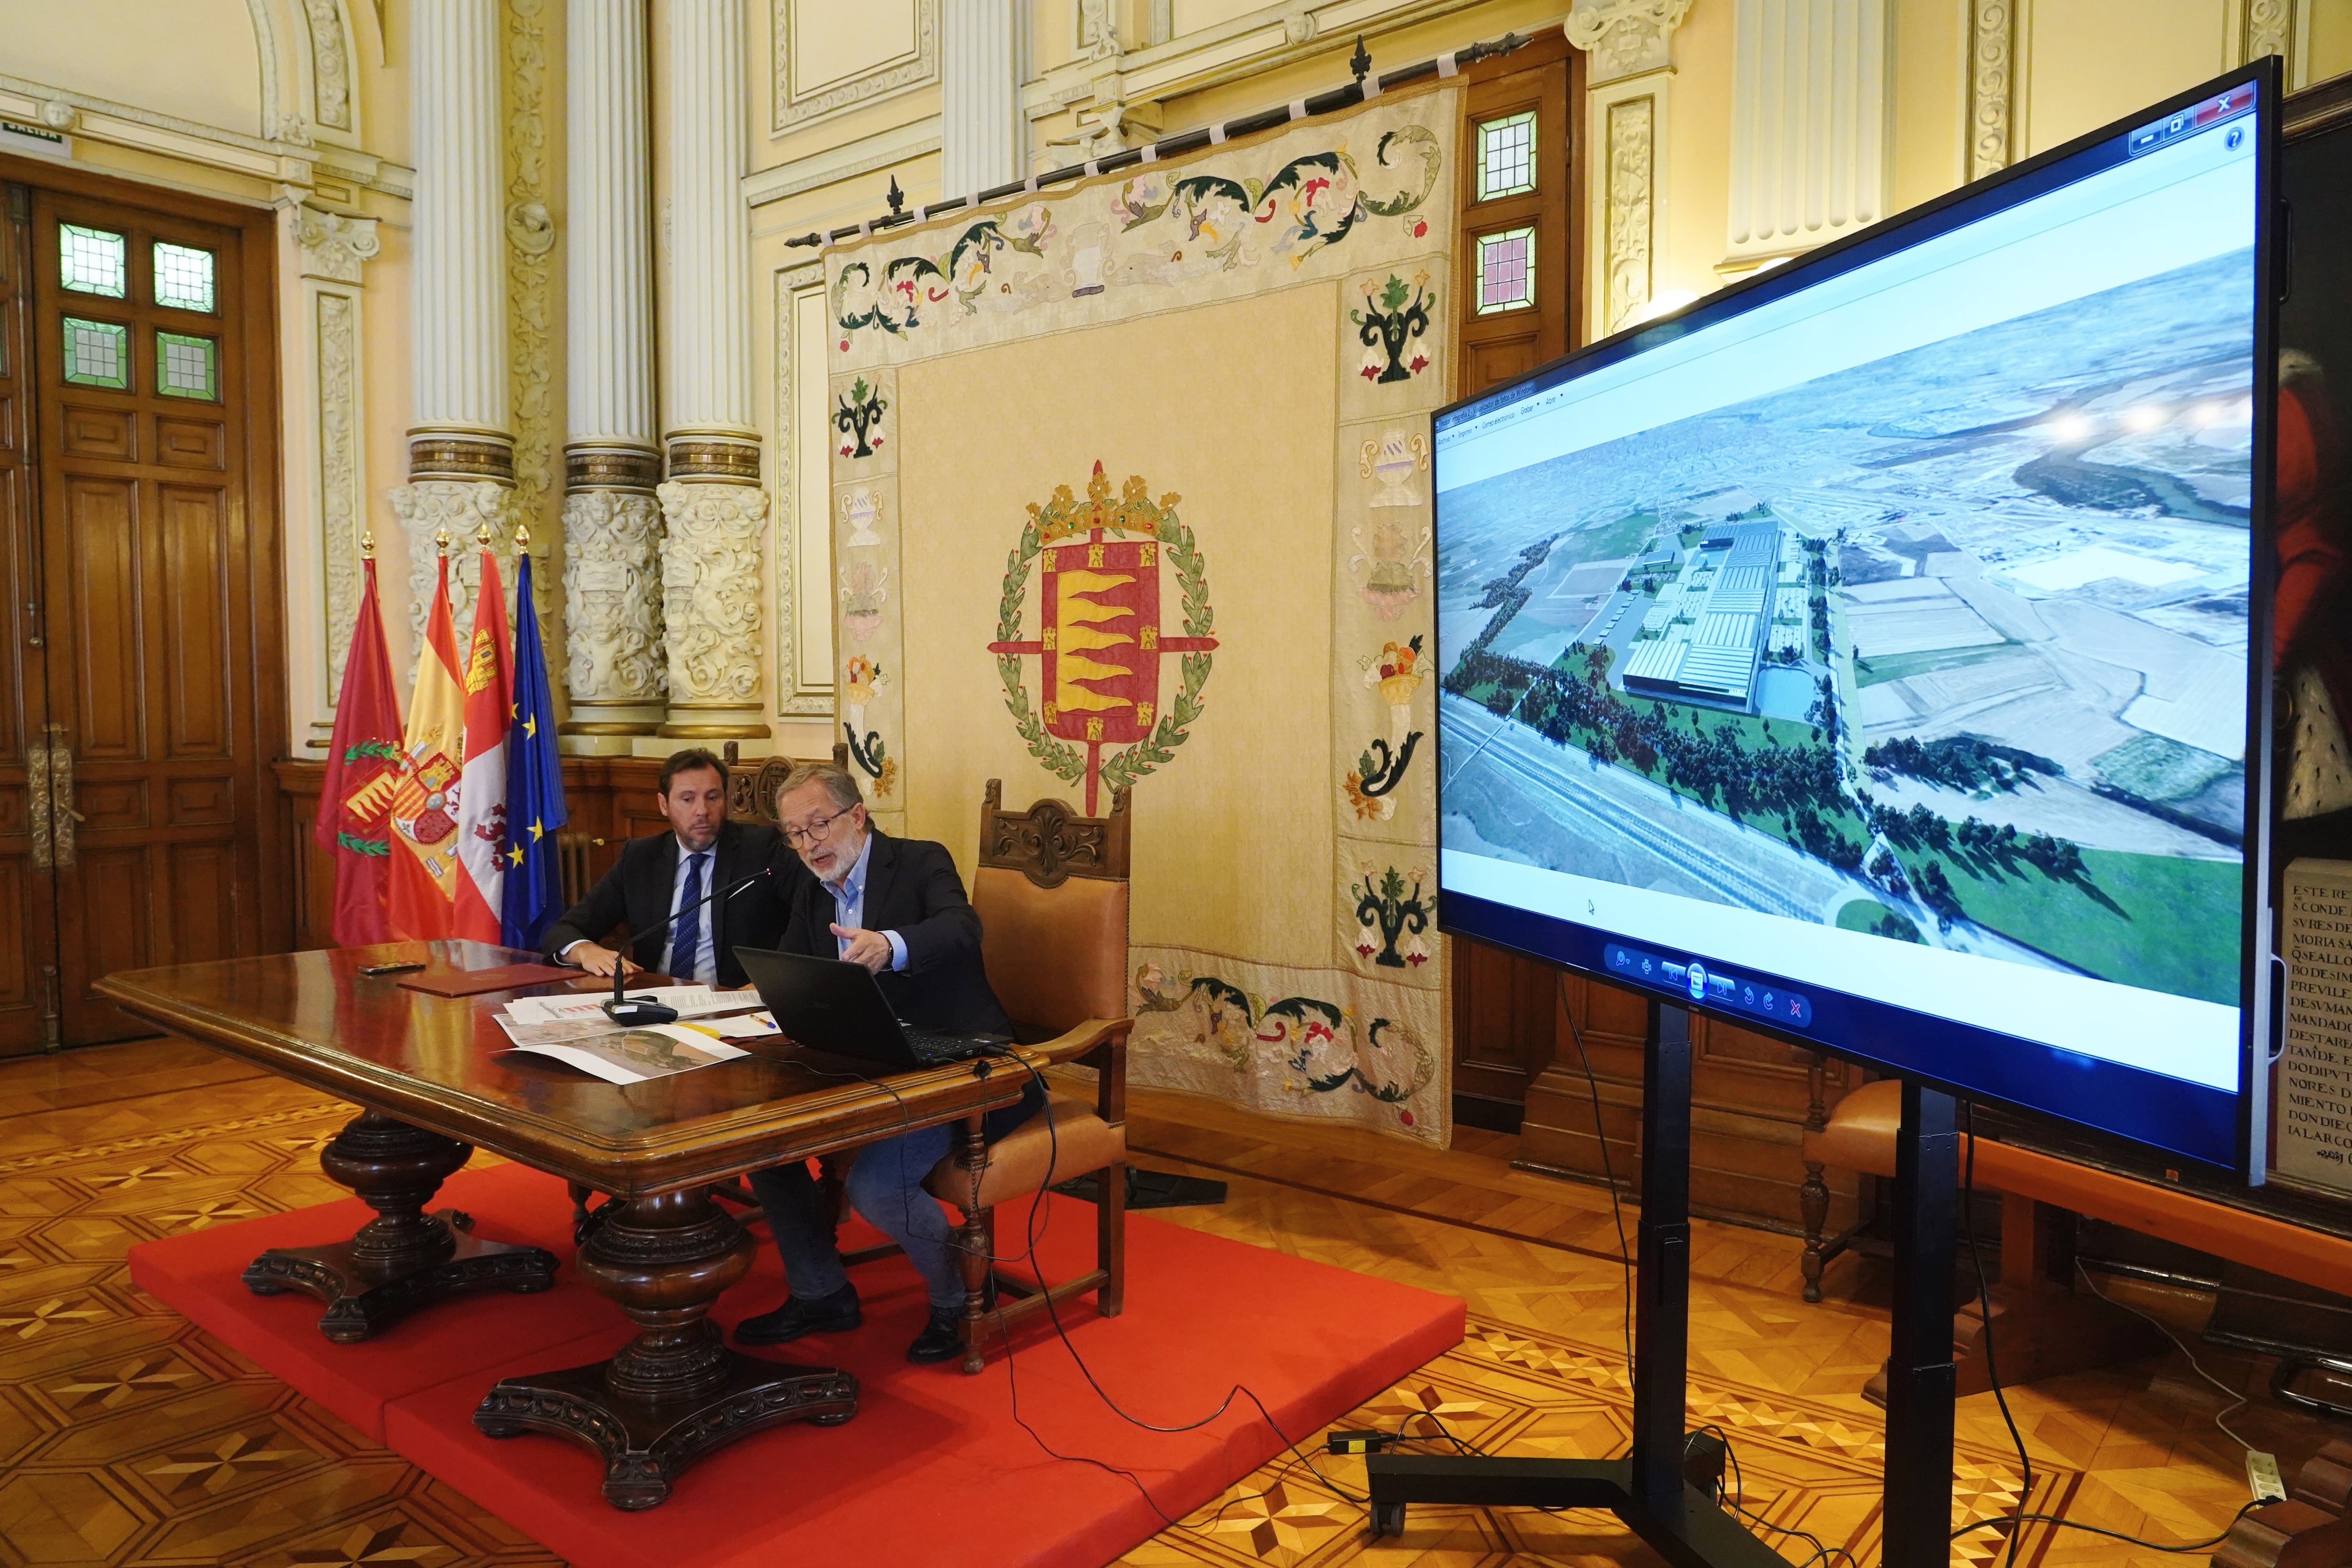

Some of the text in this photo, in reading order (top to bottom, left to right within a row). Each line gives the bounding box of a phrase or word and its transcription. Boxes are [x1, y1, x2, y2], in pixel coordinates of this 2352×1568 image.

[1516, 385, 1534, 397] Windows
[1546, 395, 1556, 405] Abrir
[1520, 405, 1534, 414] Grabar
[1482, 420, 1494, 429] Correo
[1458, 427, 1472, 438] Imprimir
[1438, 436, 1450, 445] Archivo
[2294, 885, 2328, 897] ESTE
[2293, 933, 2336, 948] MORIA
[2289, 1077, 2336, 1095] NORES
[2289, 1093, 2346, 1114] MIENTO
